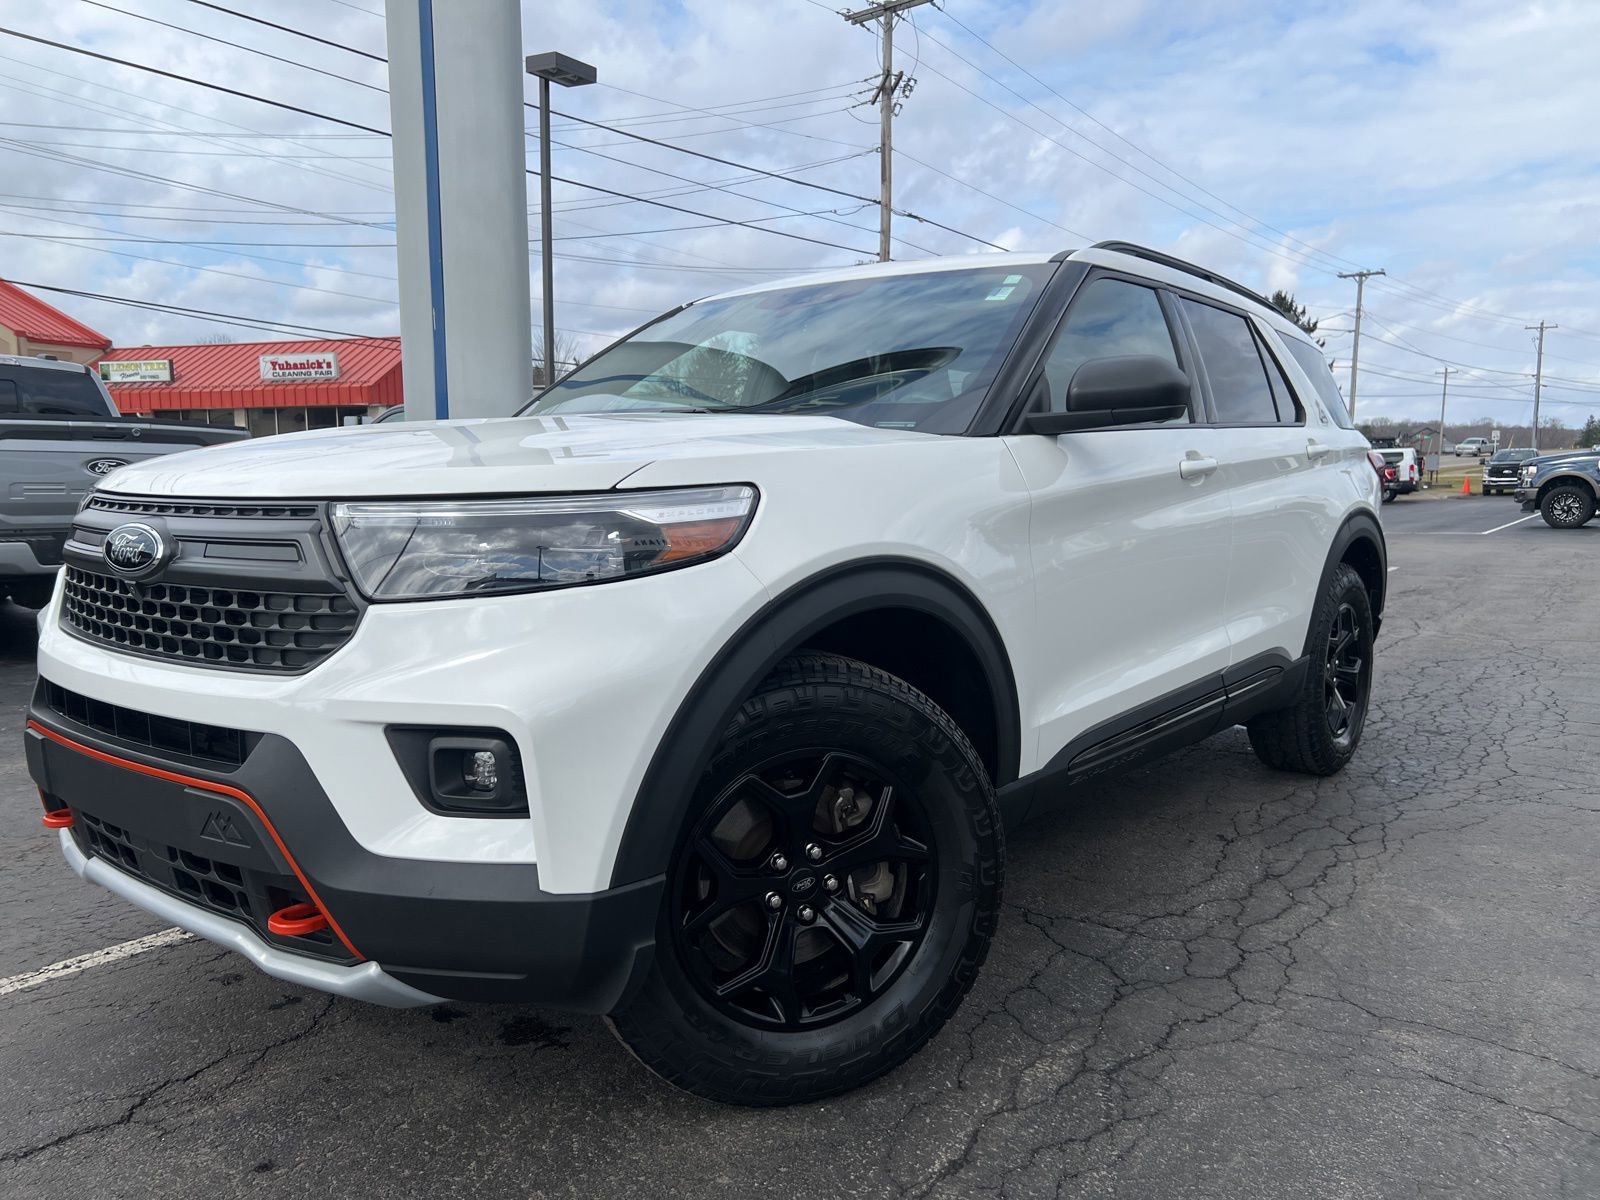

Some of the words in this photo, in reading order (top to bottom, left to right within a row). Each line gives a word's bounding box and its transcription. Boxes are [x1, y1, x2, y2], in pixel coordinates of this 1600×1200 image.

[111, 363, 142, 371] LEMON
[143, 361, 167, 371] TREE
[270, 359, 332, 370] Yuhanick's
[657, 506, 735, 518] EXPLORER
[111, 533, 145, 562] Ford
